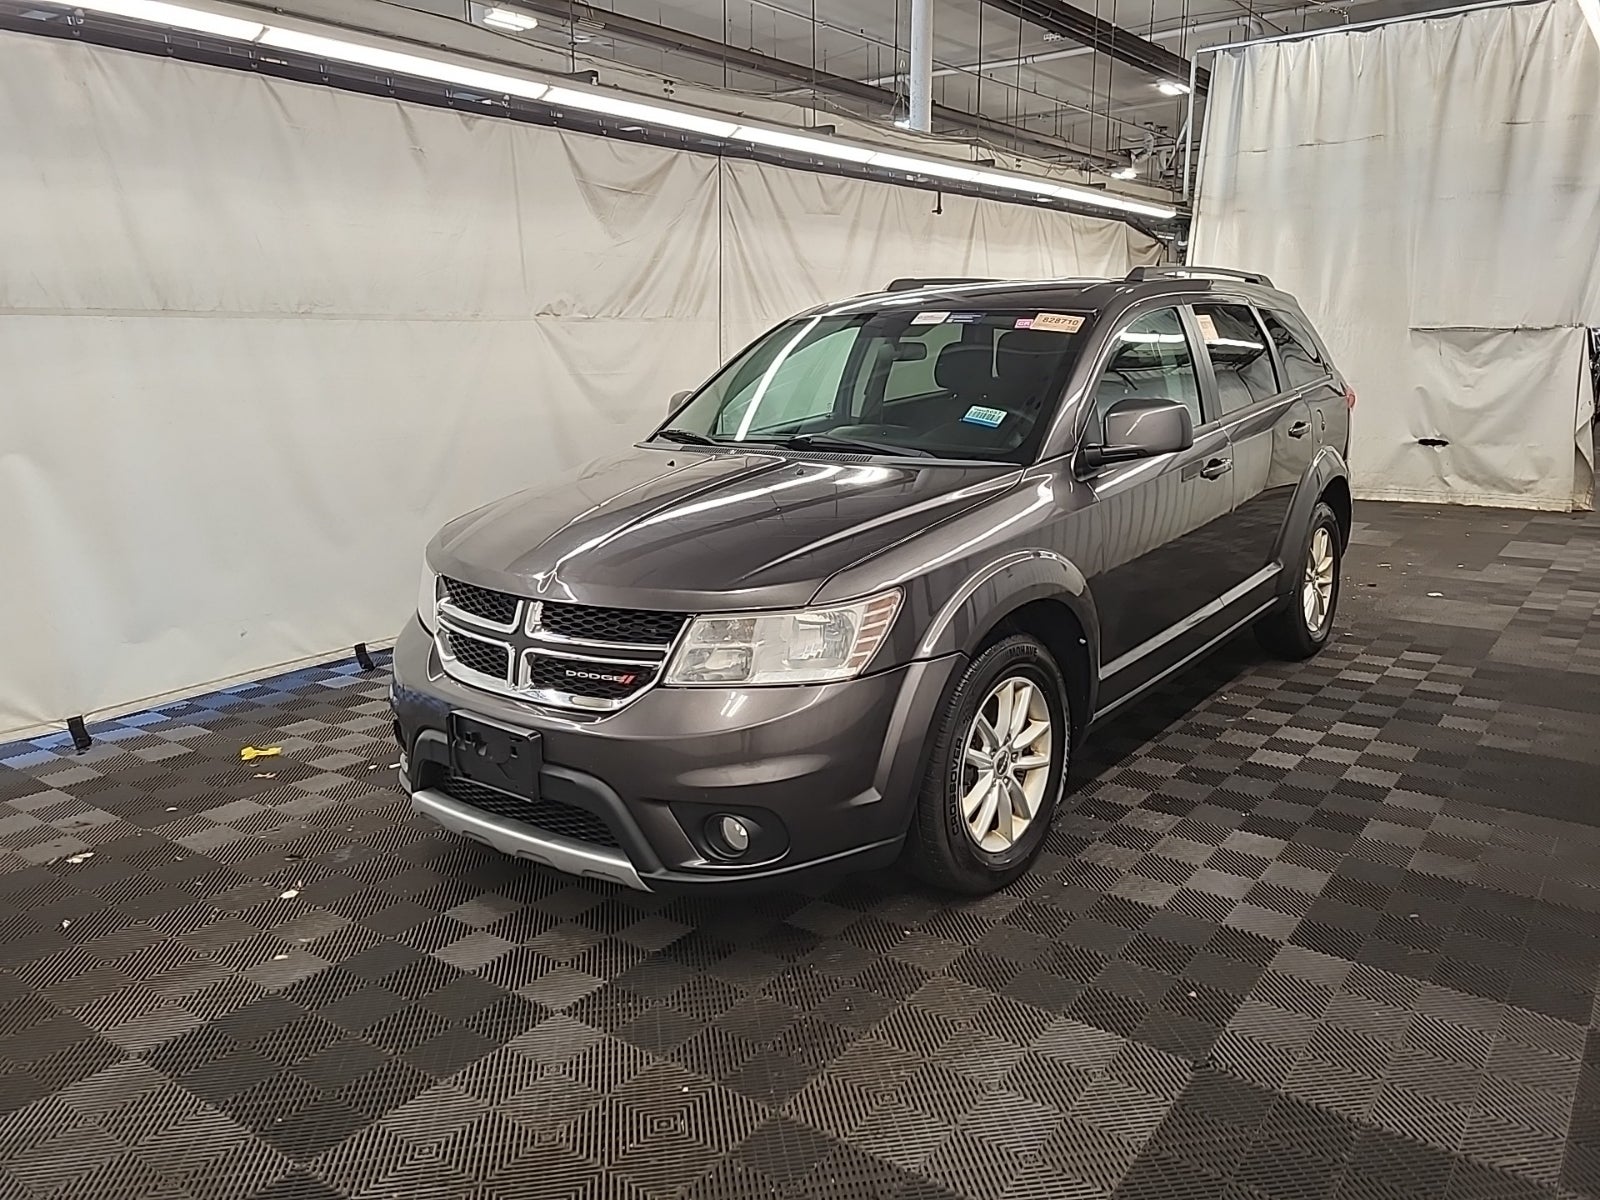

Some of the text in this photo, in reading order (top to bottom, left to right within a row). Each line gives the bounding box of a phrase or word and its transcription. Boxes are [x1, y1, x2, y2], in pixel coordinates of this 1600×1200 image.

[1042, 316, 1080, 326] 828710
[565, 669, 622, 682] DODGE
[948, 737, 963, 836] CROSSOVER
